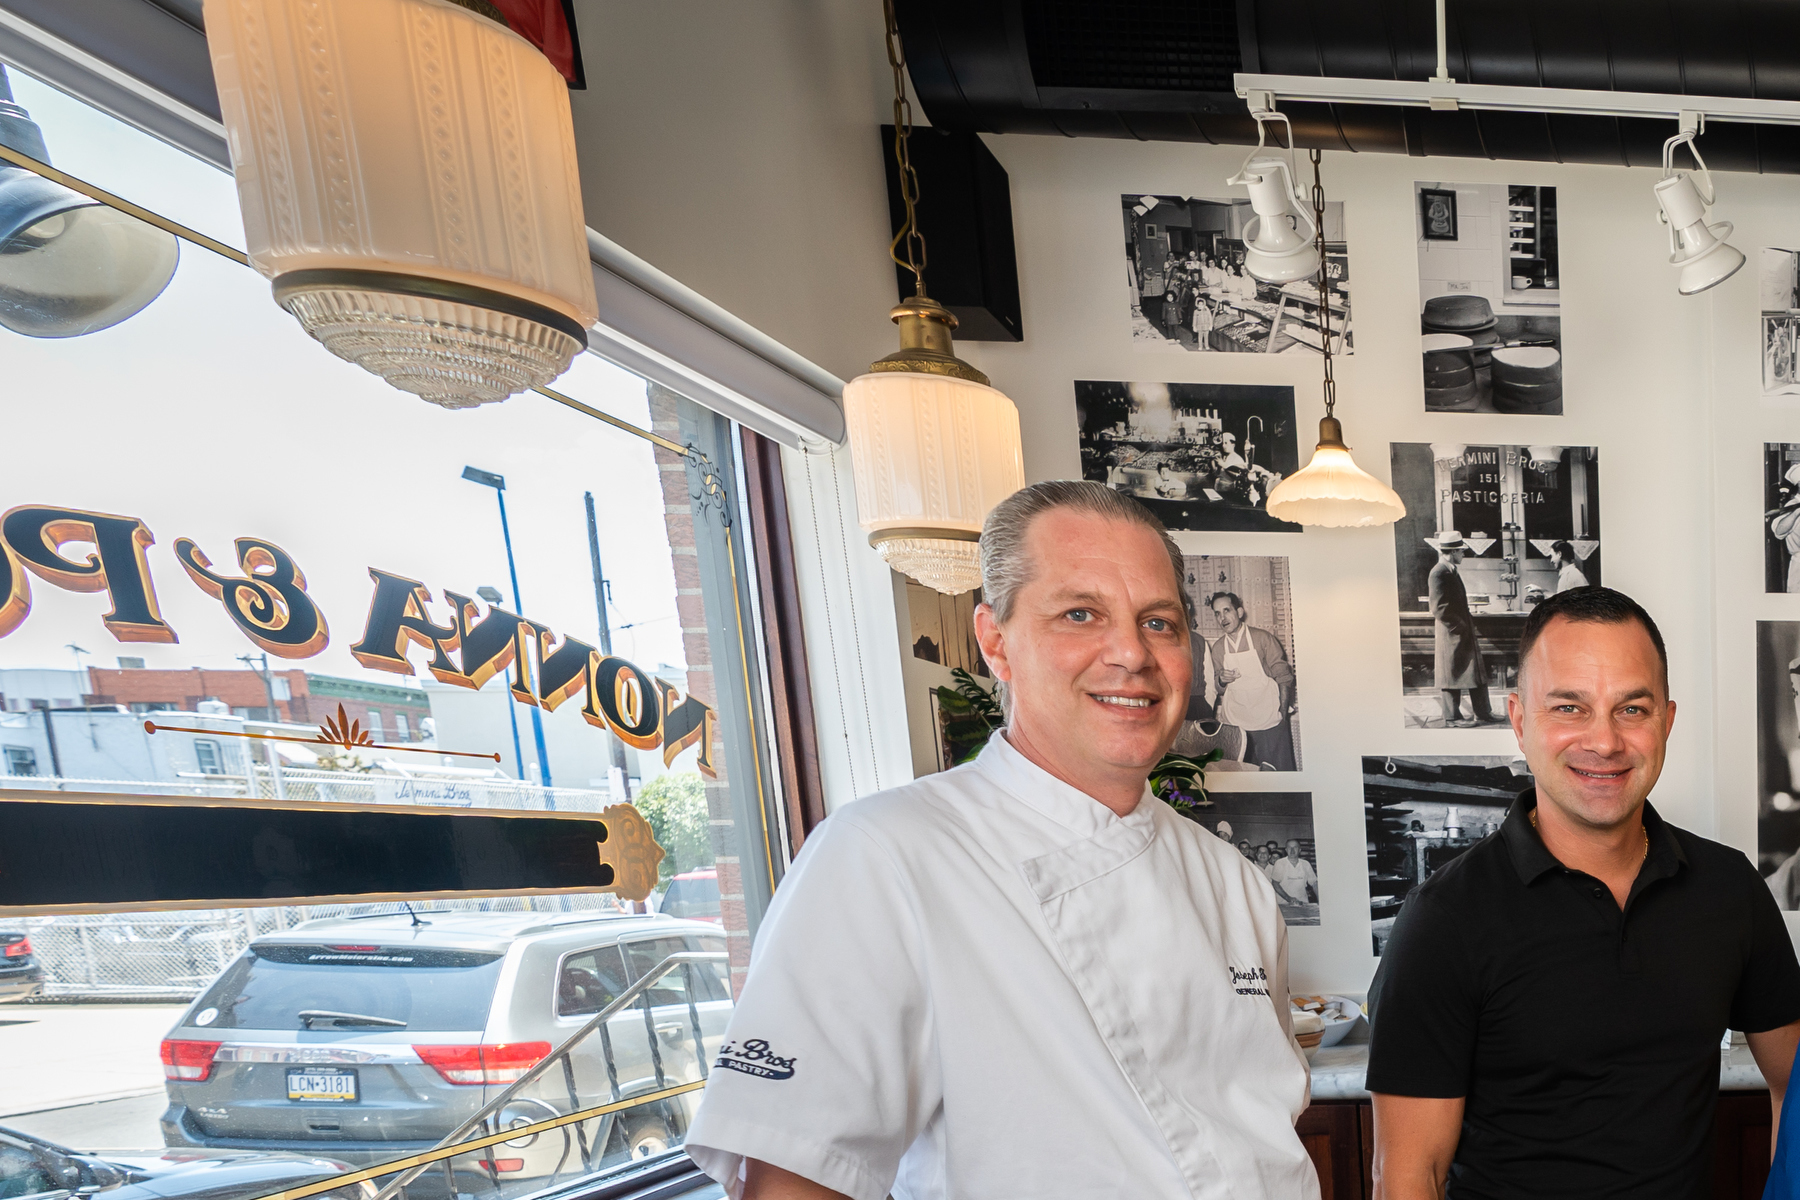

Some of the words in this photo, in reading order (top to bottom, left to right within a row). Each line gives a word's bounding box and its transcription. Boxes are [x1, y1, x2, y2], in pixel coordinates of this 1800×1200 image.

[1229, 966, 1259, 984] Joseph
[735, 1038, 798, 1069] Bros
[728, 1060, 770, 1077] PASTRY
